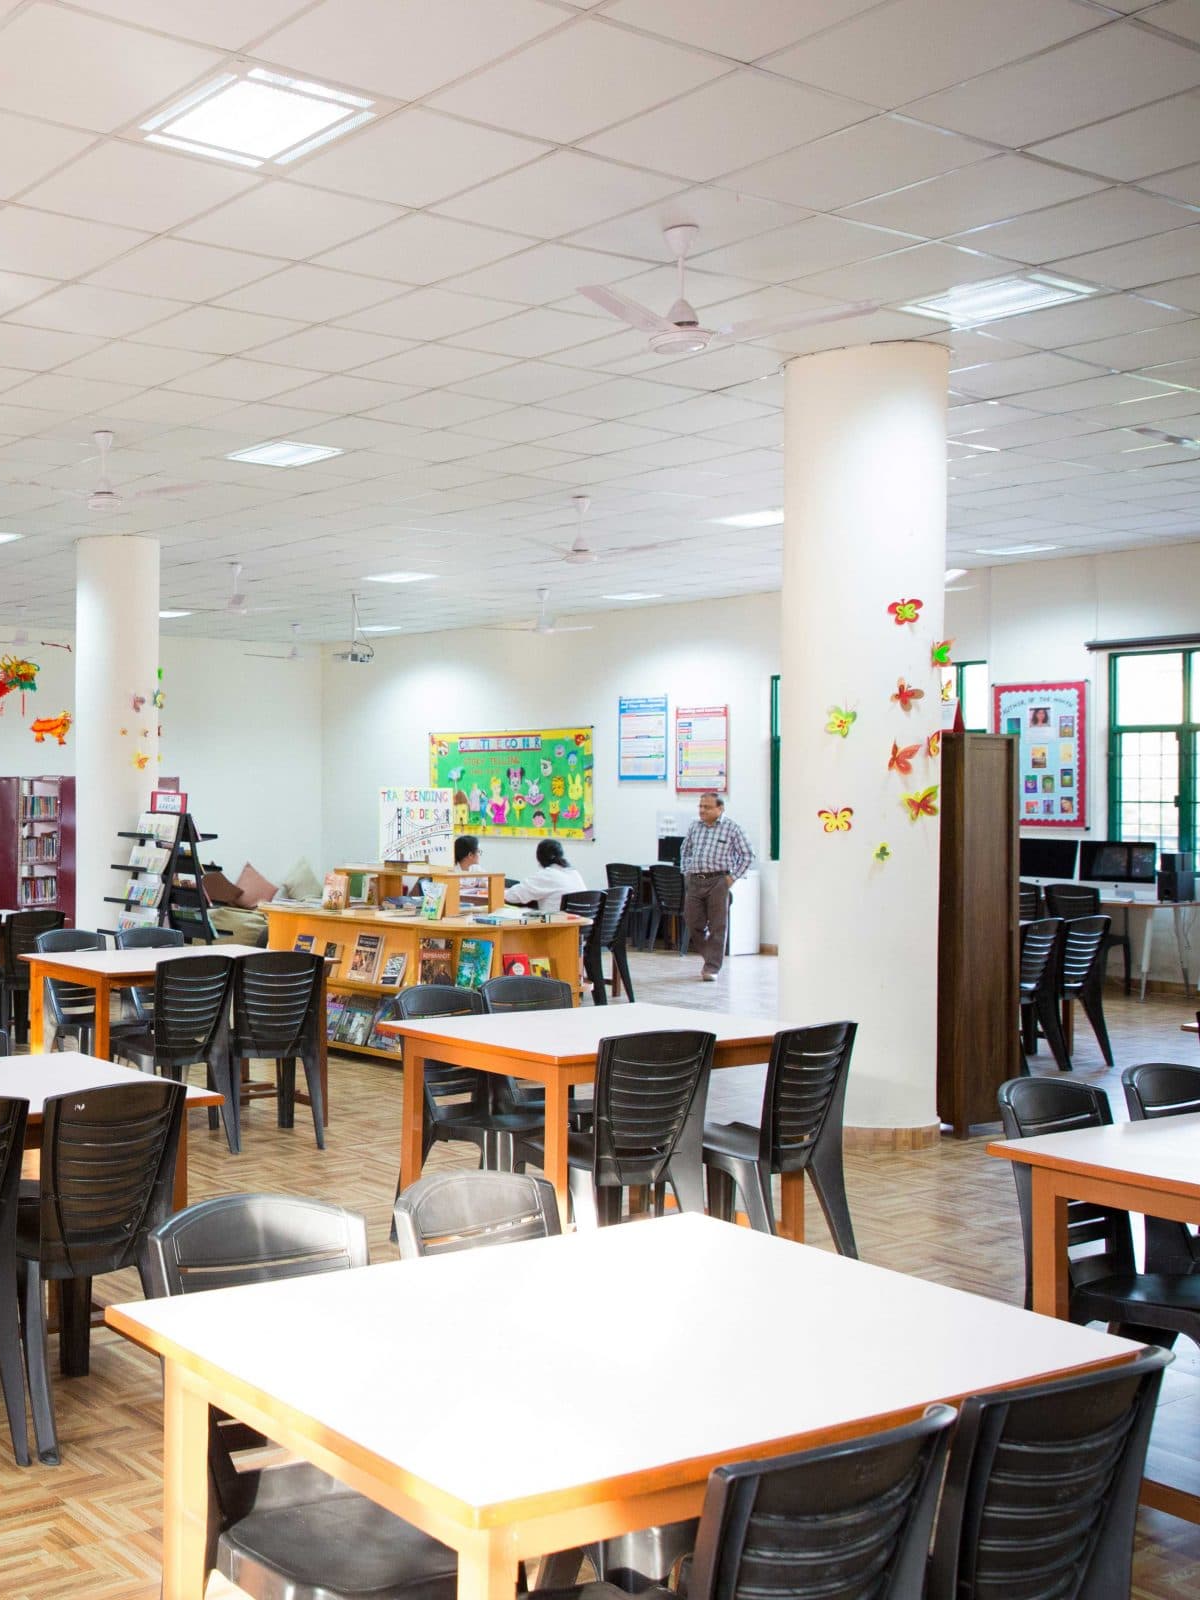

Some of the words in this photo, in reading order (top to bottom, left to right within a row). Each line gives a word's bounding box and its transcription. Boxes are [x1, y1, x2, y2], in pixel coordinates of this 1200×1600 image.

[459, 739, 501, 750] CRATIE
[505, 737, 540, 749] CONR
[381, 790, 449, 802] TRASCENDING
[405, 807, 440, 822] BODES
